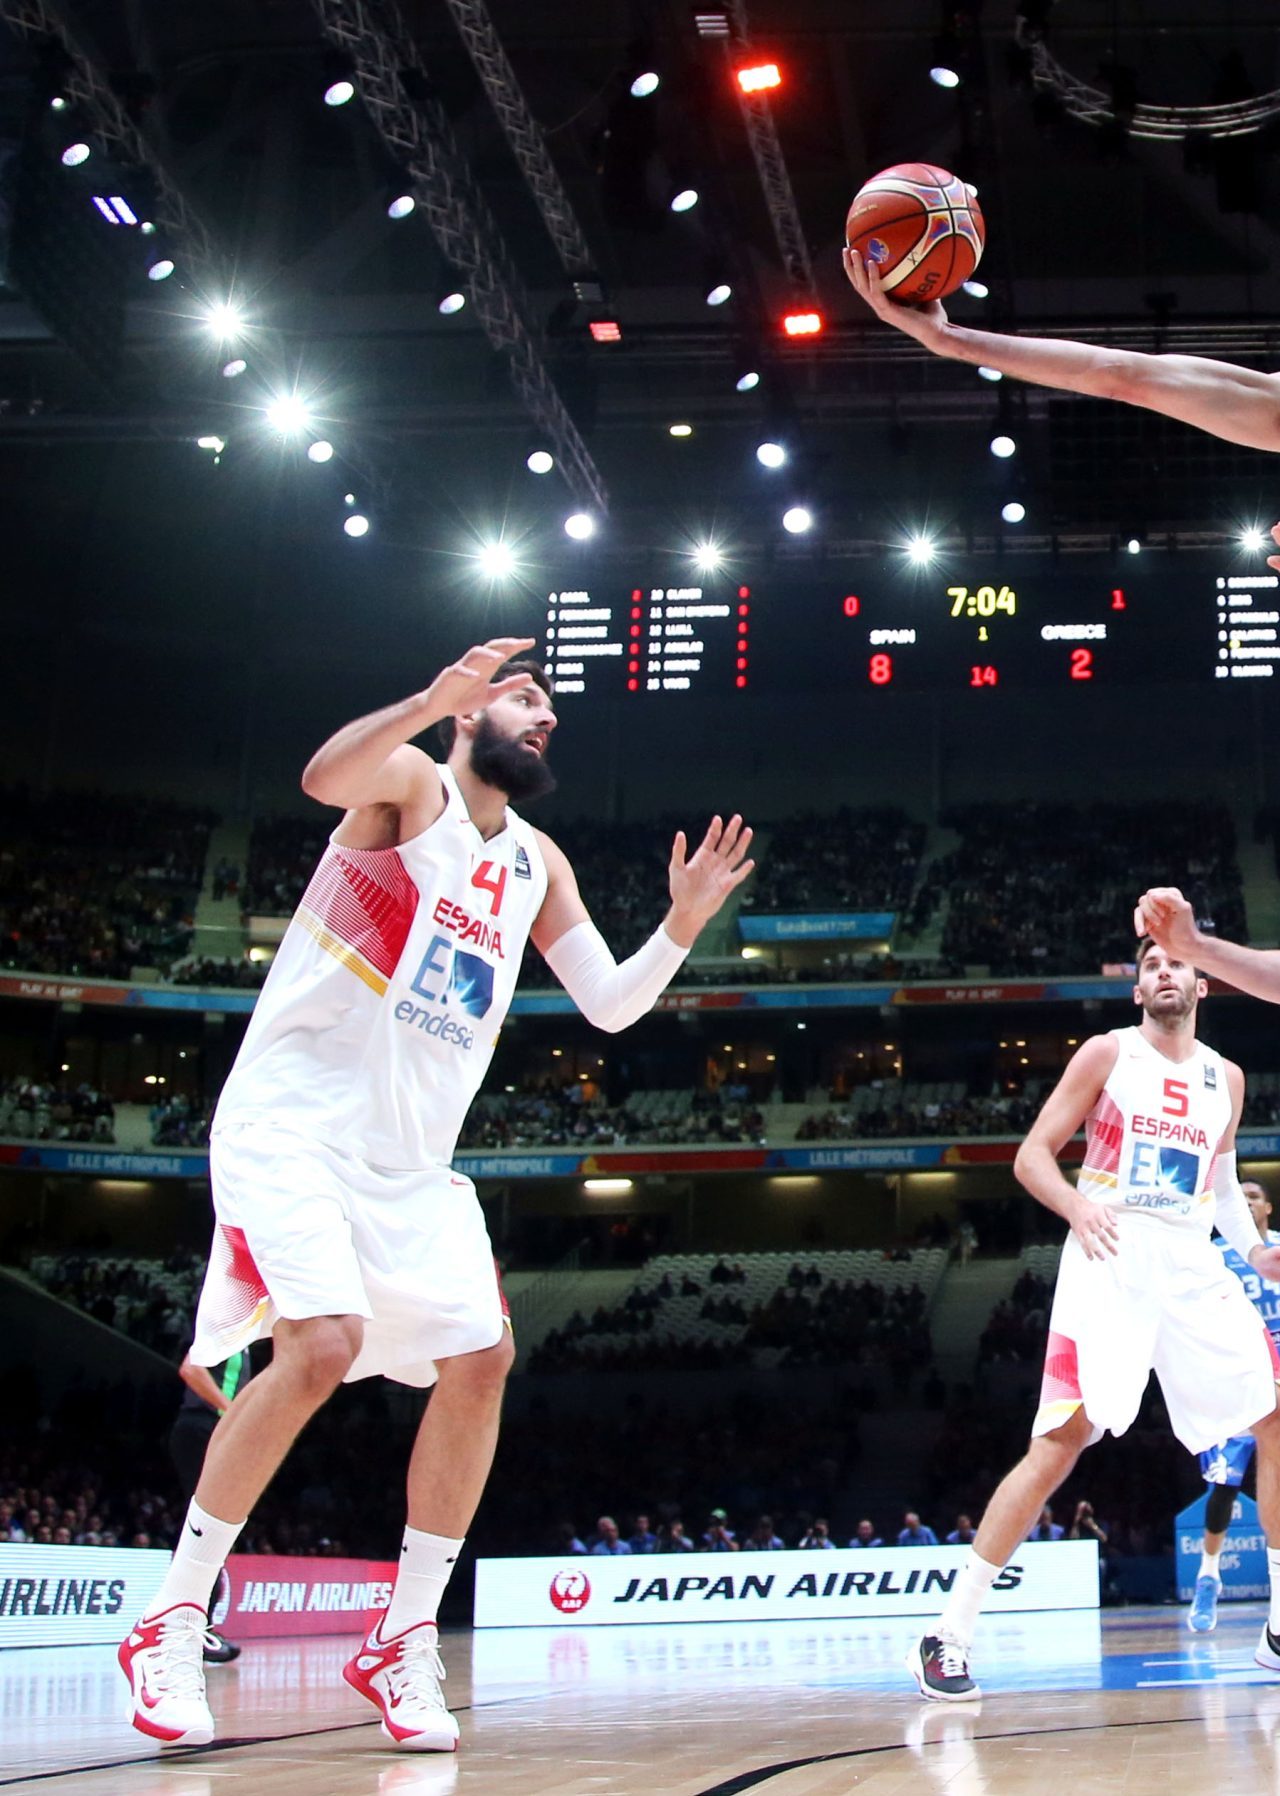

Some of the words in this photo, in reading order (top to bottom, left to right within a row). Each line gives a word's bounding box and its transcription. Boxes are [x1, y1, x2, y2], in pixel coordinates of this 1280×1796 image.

[844, 595, 860, 617] 0
[947, 586, 1016, 617] 7:04
[1112, 589, 1126, 610] 1
[870, 629, 916, 645] SPAIN
[978, 626, 988, 641] 1
[1041, 623, 1107, 640] GREECE
[869, 653, 892, 684] 8
[970, 665, 997, 687] 14
[1071, 648, 1093, 679] 2
[471, 860, 507, 916] 4
[432, 897, 505, 959] ESPAÑA
[394, 1000, 474, 1050] endesa
[1162, 1078, 1189, 1117] 5
[1131, 1115, 1210, 1150] ESPAÑA
[67, 1152, 101, 1169] LILLE
[809, 1151, 841, 1166] LILLE
[1125, 1193, 1191, 1215] endesa
[0, 1579, 126, 1616] IRLINES
[237, 1581, 301, 1613] JAPAN
[299, 1582, 393, 1611] AIRLINES
[613, 1574, 775, 1603] JAPAN
[787, 1564, 1026, 1598] AIRLINS
